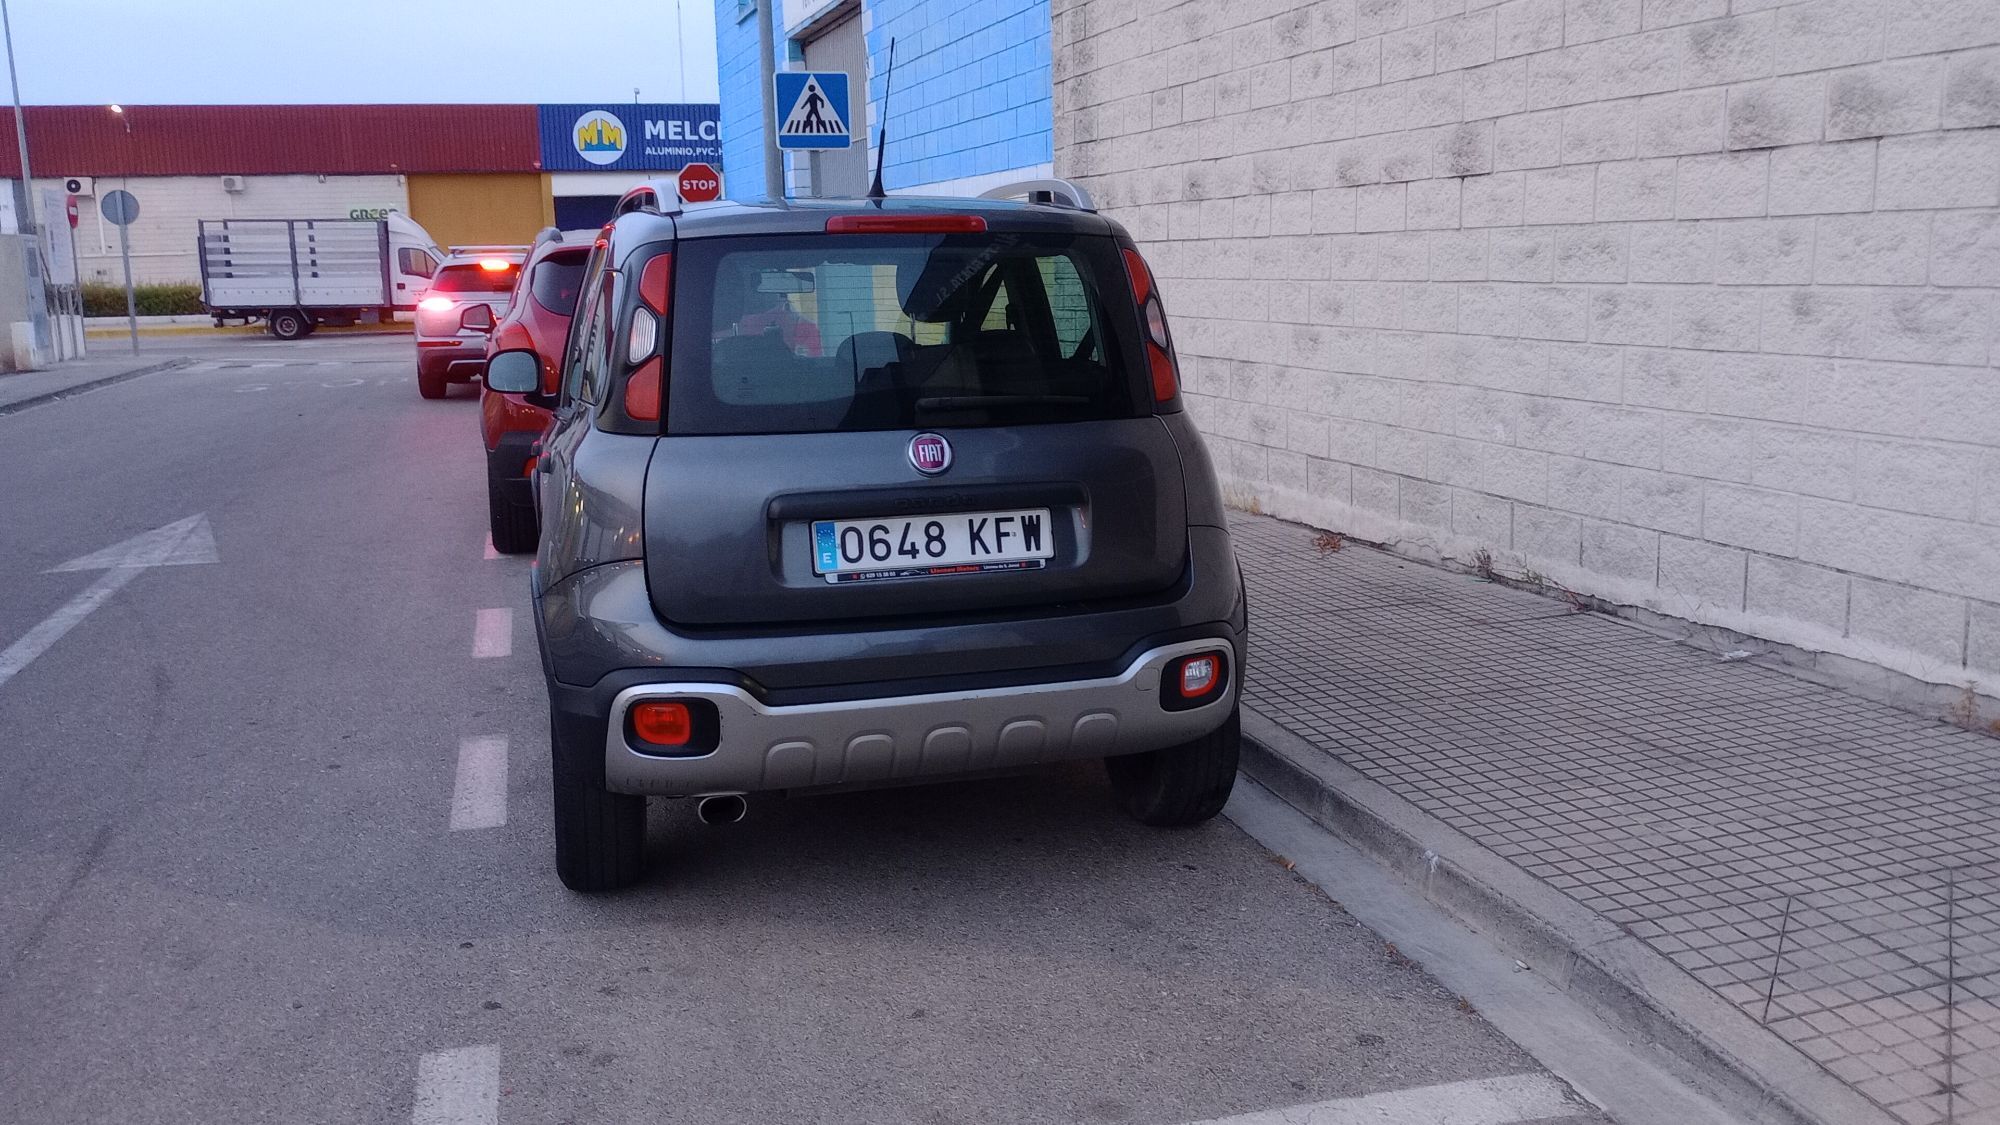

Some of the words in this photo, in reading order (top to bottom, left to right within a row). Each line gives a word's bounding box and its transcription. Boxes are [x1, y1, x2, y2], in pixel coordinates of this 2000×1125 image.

[645, 120, 722, 141] MELC
[682, 179, 717, 190] STOP
[918, 443, 942, 462] FIAT
[840, 521, 947, 564] 0648
[968, 514, 1041, 556] KFW
[823, 553, 832, 563] E
